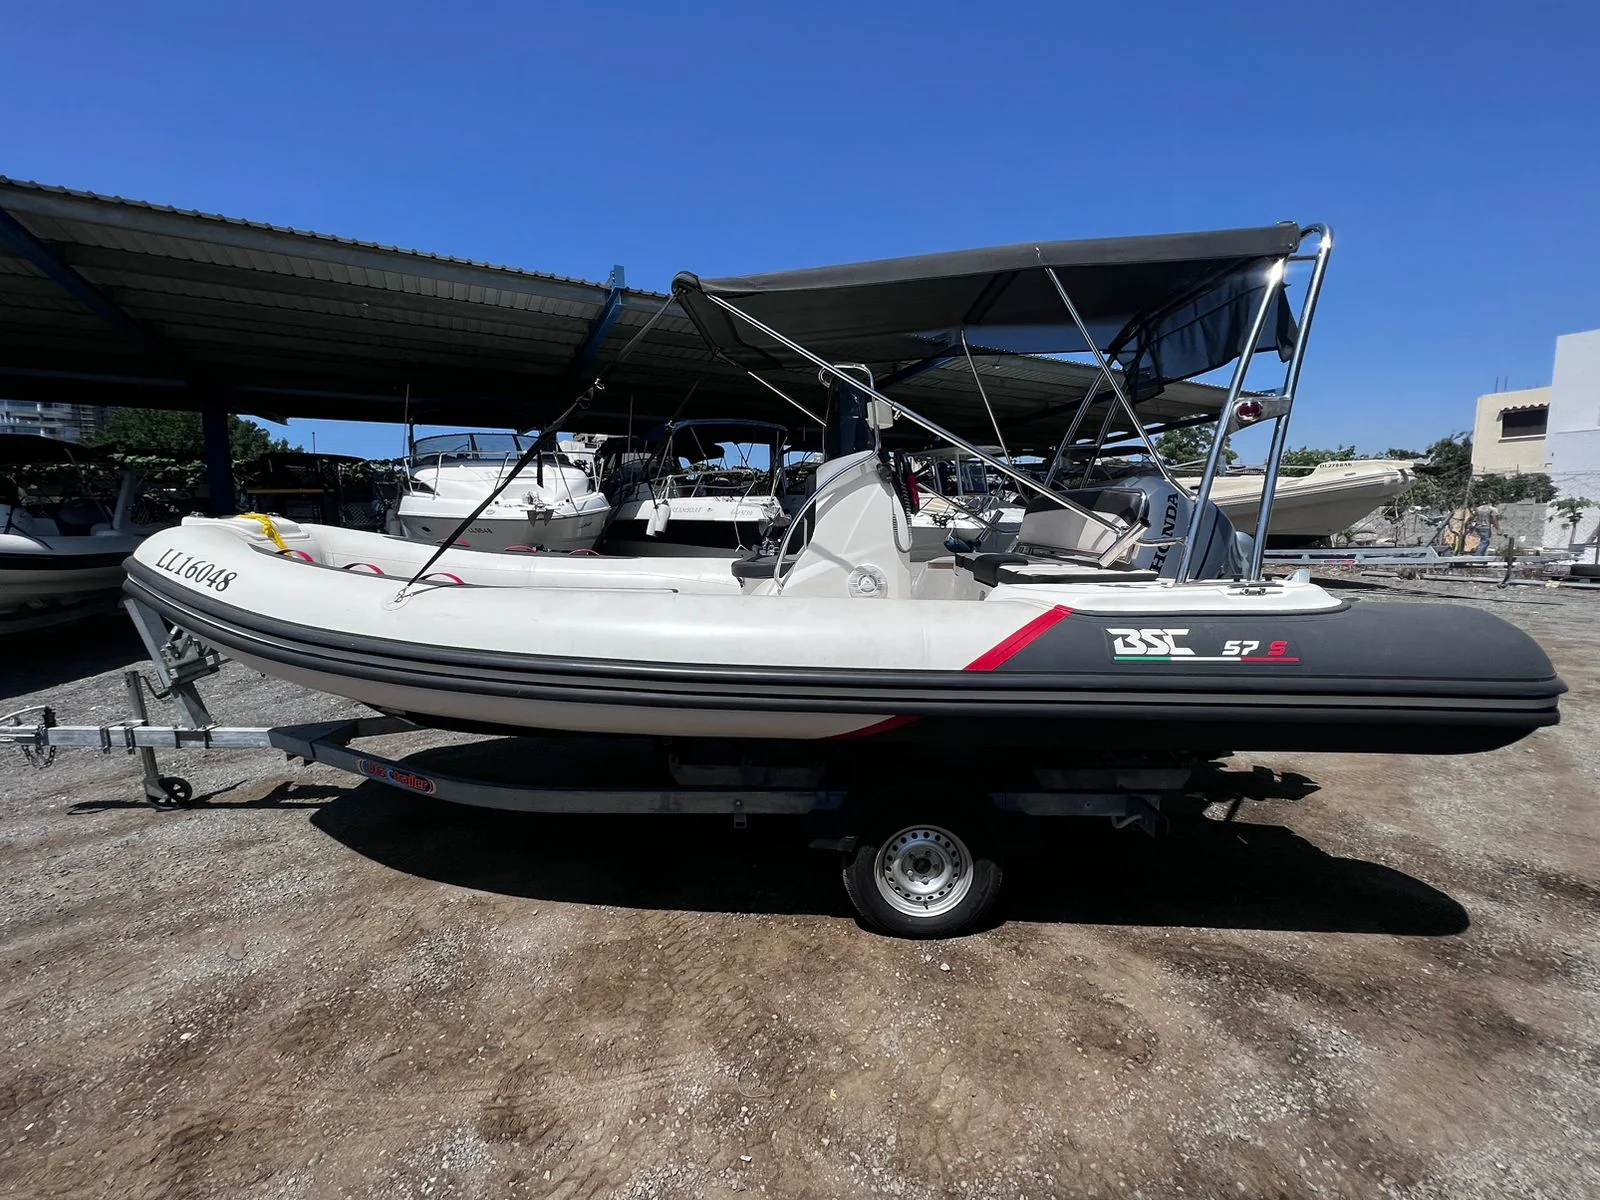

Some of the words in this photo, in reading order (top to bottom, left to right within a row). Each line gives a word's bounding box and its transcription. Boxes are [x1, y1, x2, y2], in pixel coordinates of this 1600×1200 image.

[155, 548, 238, 592] LL16048
[1106, 628, 1196, 656] BSC
[1266, 640, 1288, 656] S
